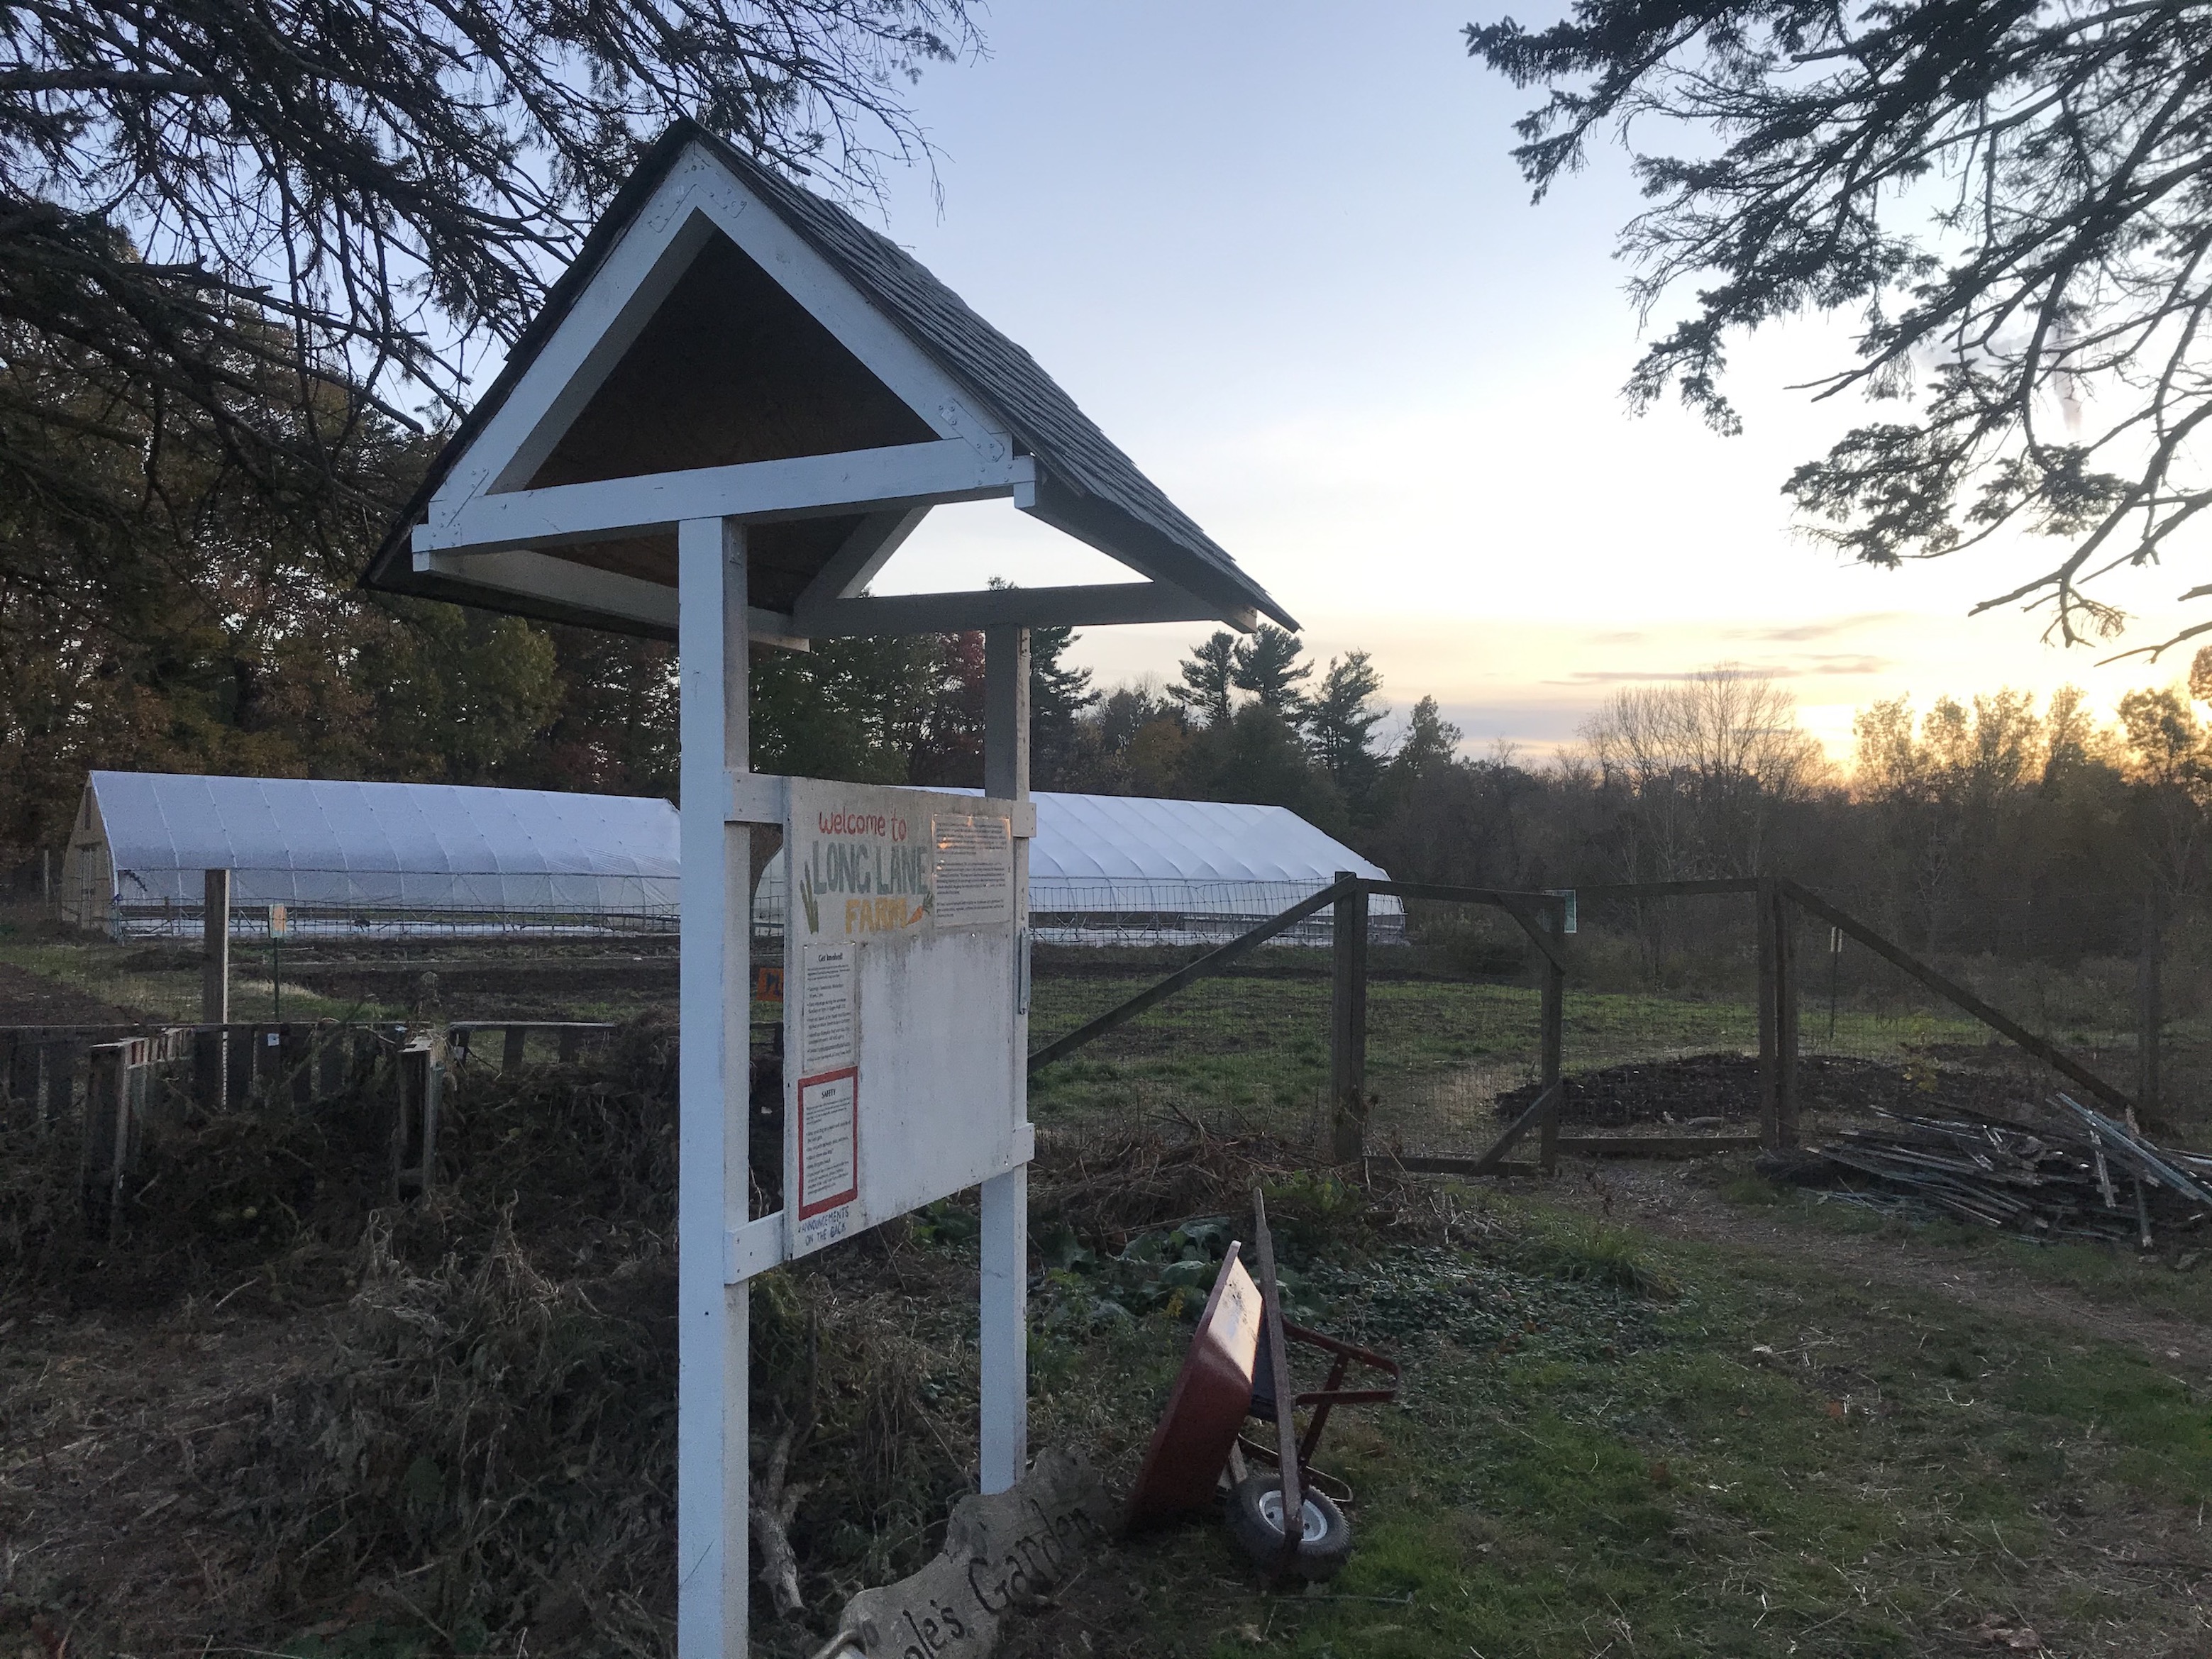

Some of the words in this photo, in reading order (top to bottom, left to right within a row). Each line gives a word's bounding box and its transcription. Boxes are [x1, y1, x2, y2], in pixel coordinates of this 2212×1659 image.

[819, 806, 885, 837] welcome
[890, 808, 907, 842] to
[812, 840, 870, 895] LONG
[875, 845, 929, 895] LANE
[845, 897, 907, 934] FARM
[822, 1089, 836, 1099] SAFETY
[805, 1234, 814, 1246] ON
[817, 1228, 827, 1241] THE
[830, 1222, 846, 1238] BACK
